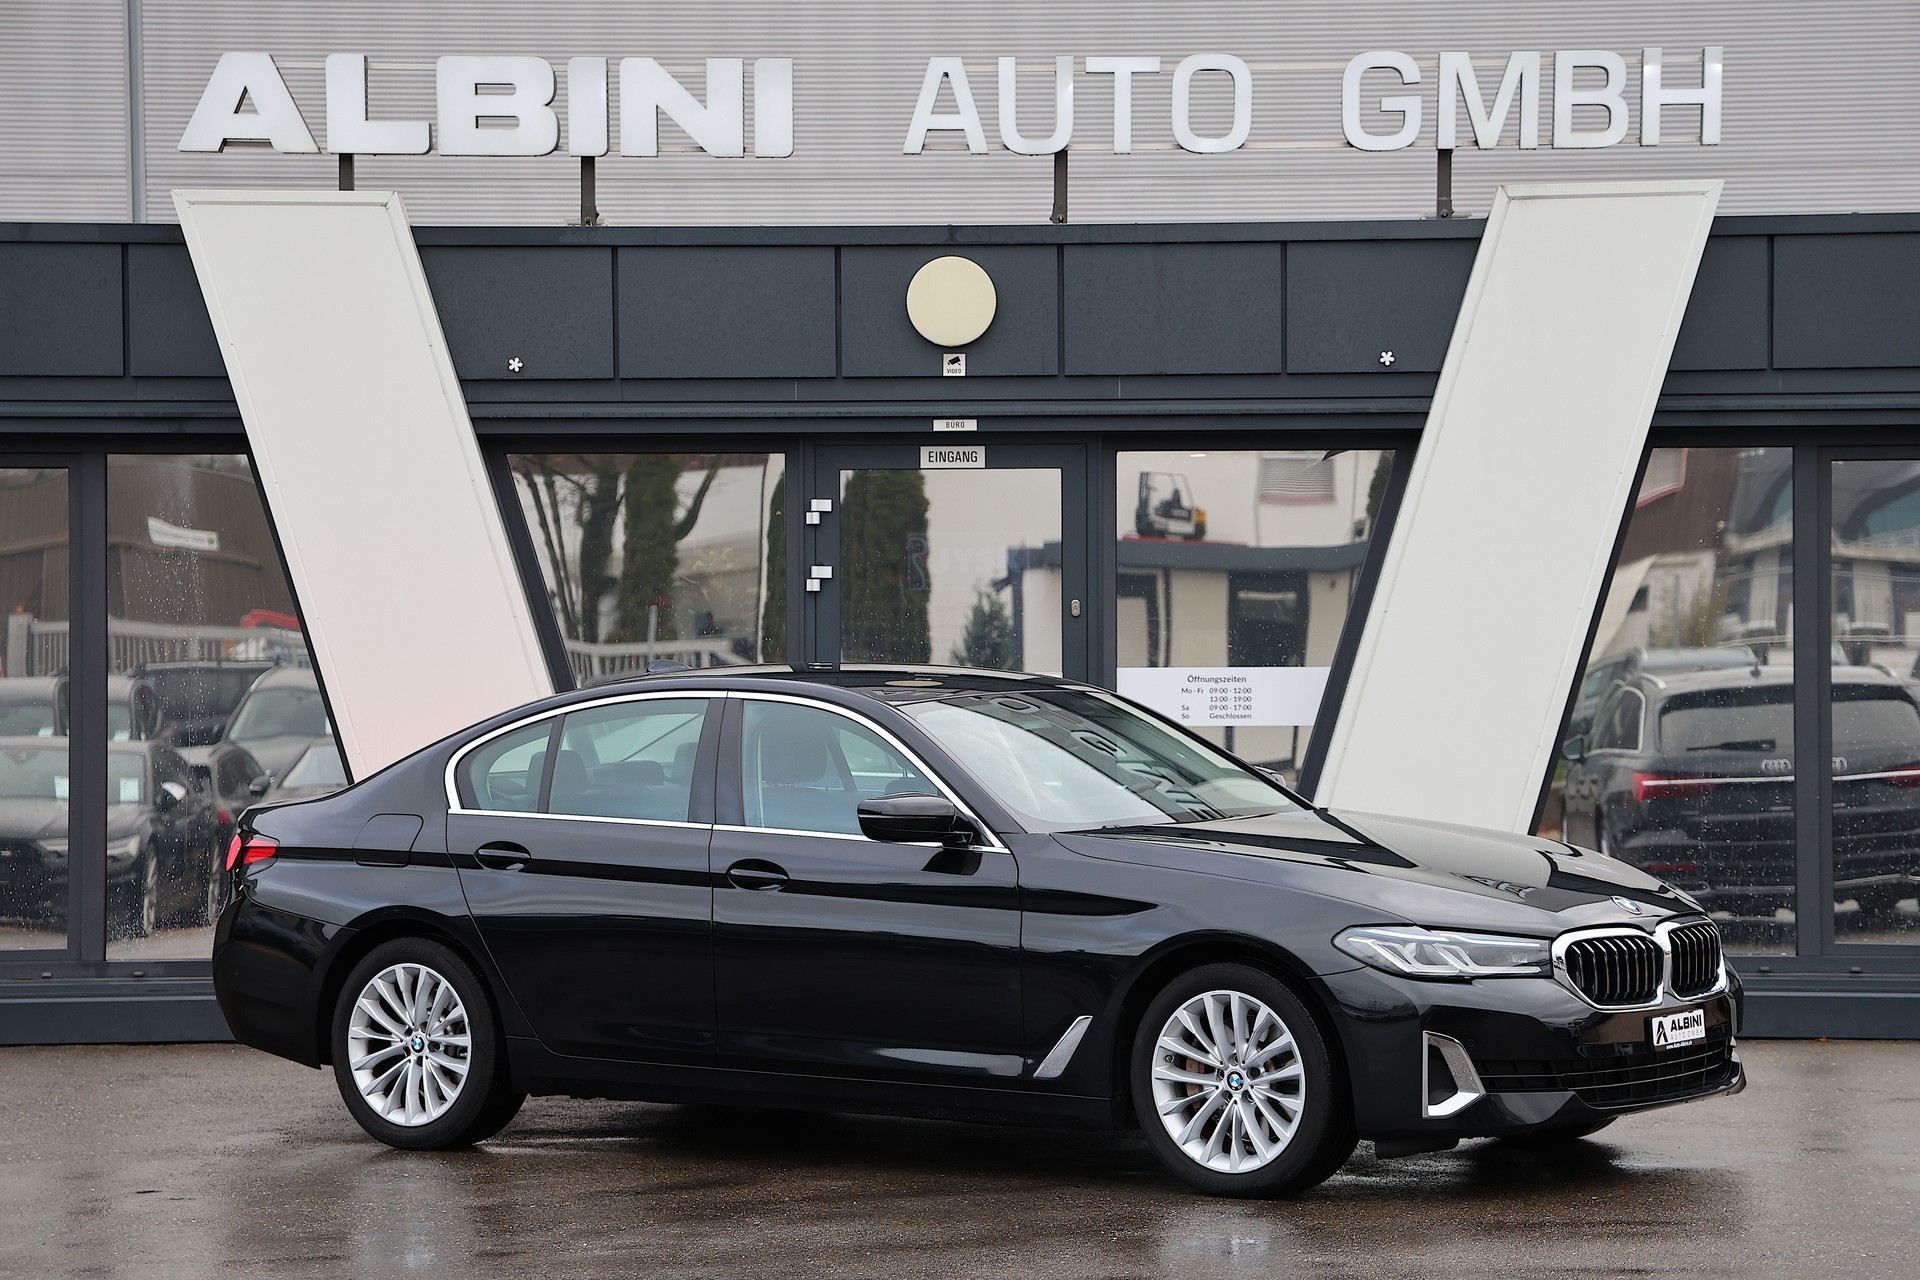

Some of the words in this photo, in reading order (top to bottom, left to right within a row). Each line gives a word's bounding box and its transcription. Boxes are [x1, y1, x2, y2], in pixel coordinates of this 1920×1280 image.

[177, 51, 795, 159] ALBINI
[902, 52, 1253, 156] AUTO
[1341, 46, 1723, 152] GMBH
[945, 420, 965, 428] BÜRO
[928, 451, 978, 462] EINGANG
[1187, 674, 1247, 684] Öffnungszeiten
[1670, 1014, 1702, 1032] ALBINI
